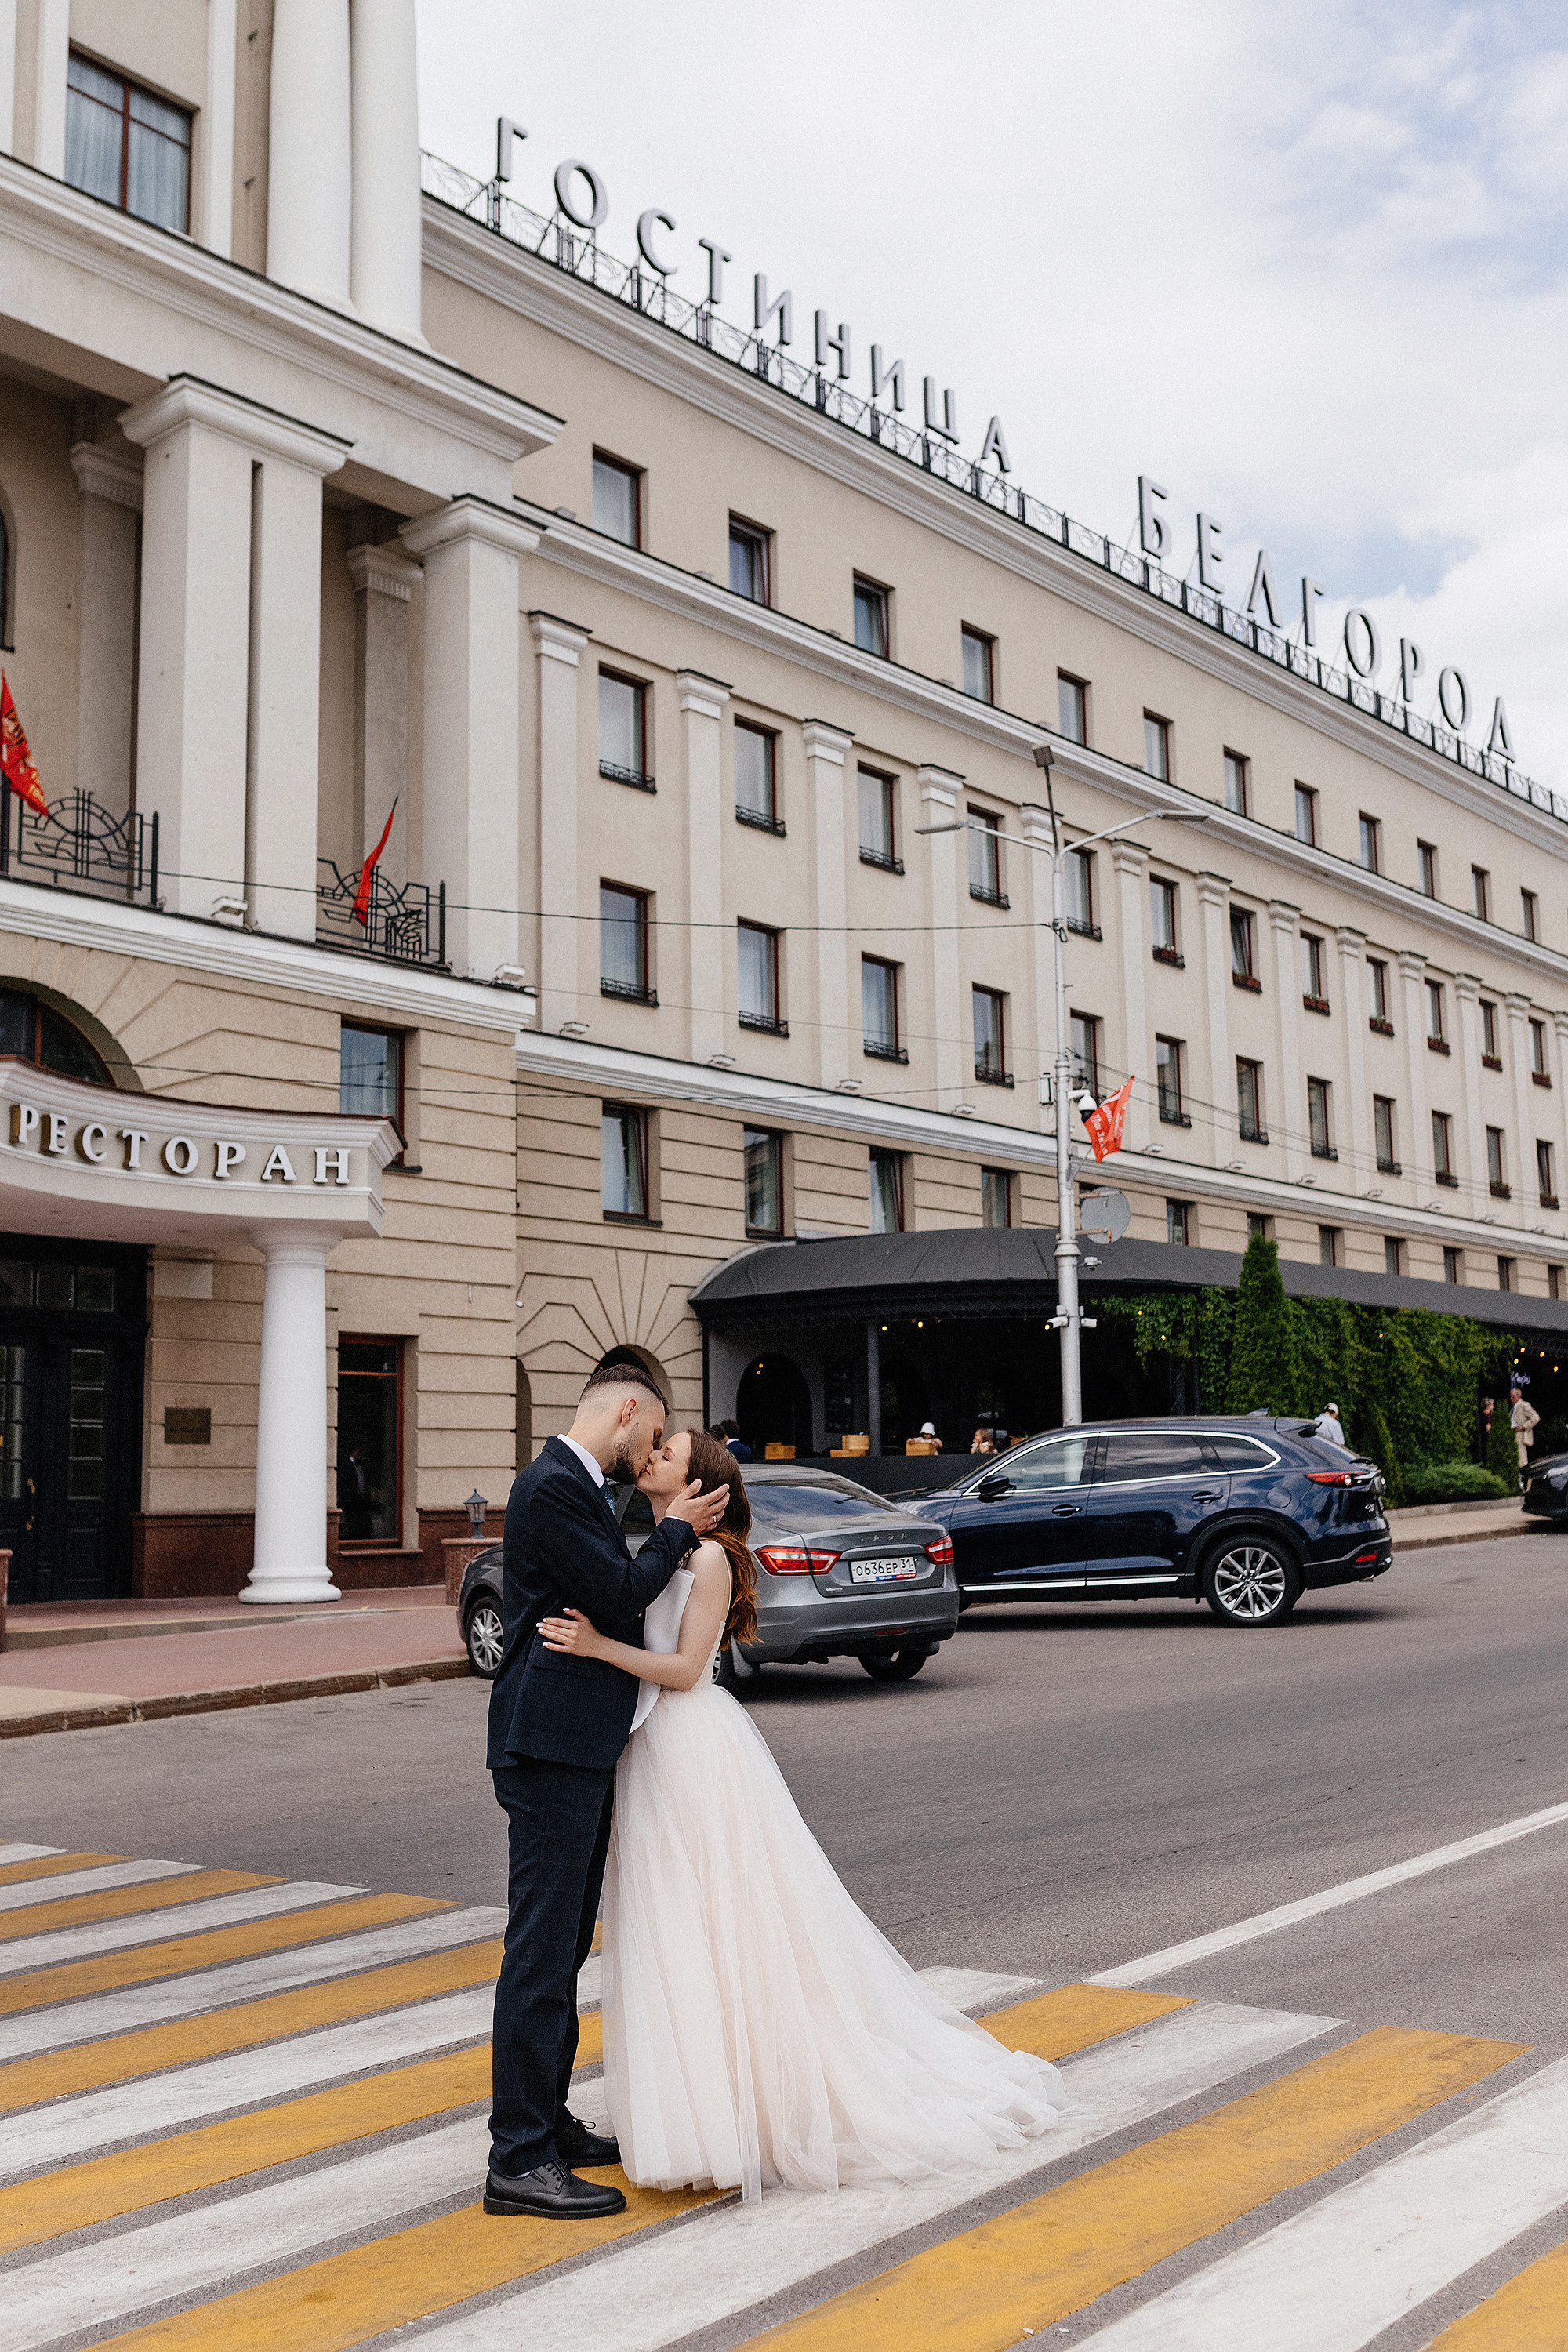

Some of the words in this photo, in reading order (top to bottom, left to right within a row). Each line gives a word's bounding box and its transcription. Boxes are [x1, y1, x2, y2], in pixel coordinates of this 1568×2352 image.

[498, 116, 1011, 472] ГОСТИНИЦА
[1138, 475, 1515, 763] БЕЛГОРОД
[12, 1104, 350, 1185] РЕСТОРАН
